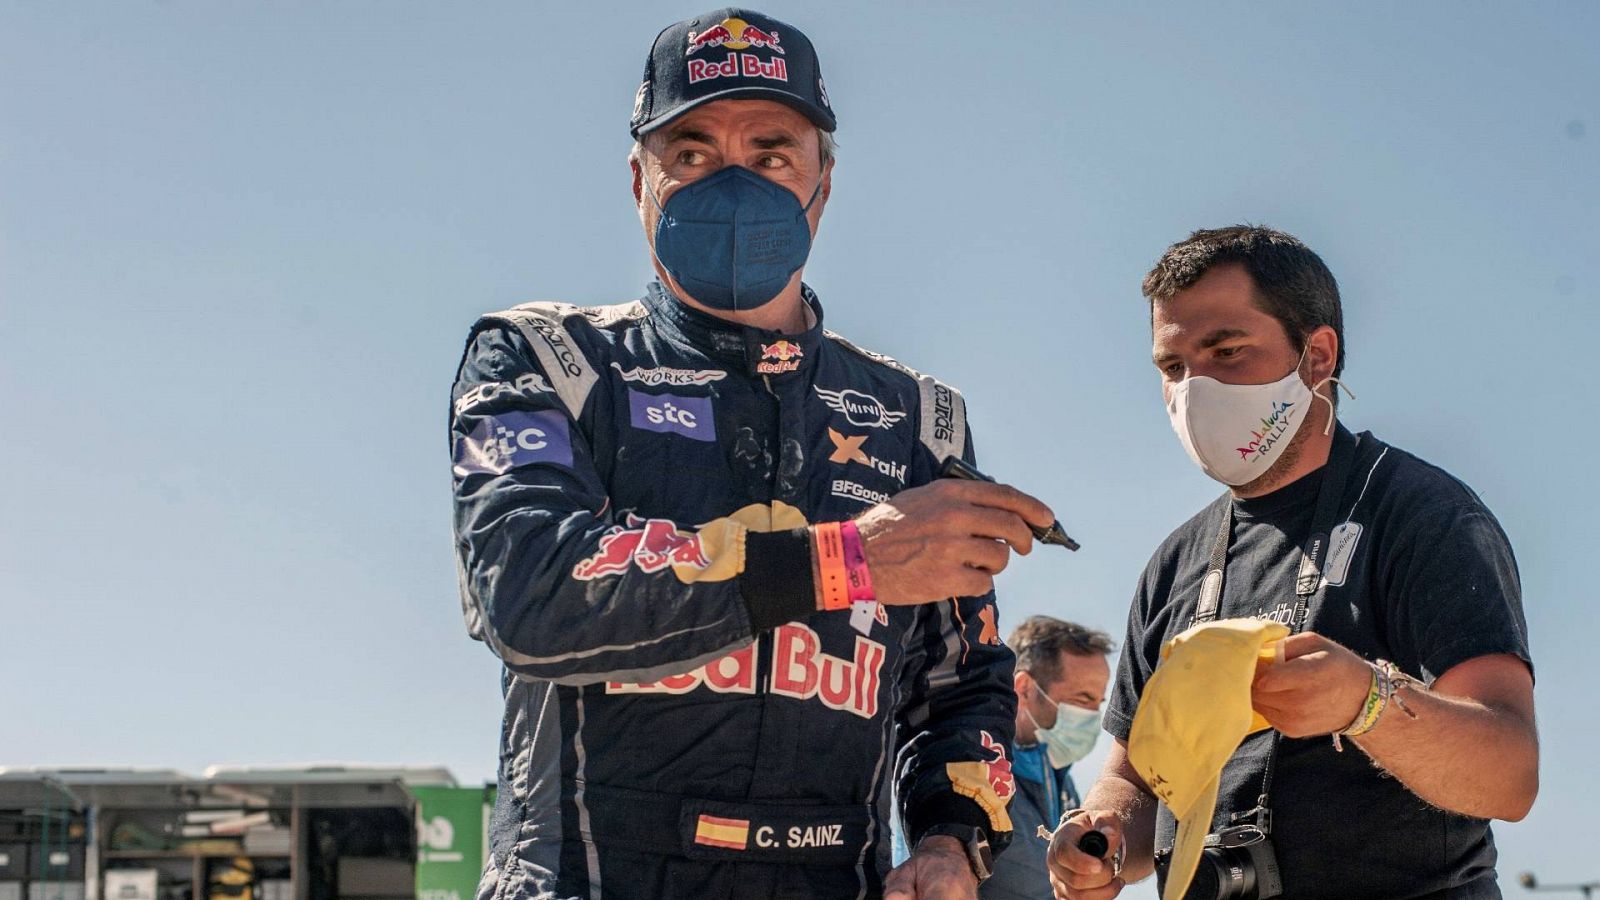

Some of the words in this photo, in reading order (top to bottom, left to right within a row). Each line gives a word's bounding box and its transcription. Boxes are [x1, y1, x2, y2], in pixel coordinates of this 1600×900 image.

[688, 53, 739, 84] Red
[741, 54, 788, 82] Bull
[524, 317, 582, 378] sparco
[637, 370, 695, 384] WORKS
[646, 402, 697, 428] stc
[845, 399, 880, 417] MINI
[934, 384, 953, 441] sparco
[482, 426, 548, 462] stc
[1236, 401, 1295, 461] Andalucía
[1258, 415, 1289, 456] RALLY
[831, 480, 892, 503] BFGood
[770, 621, 886, 719] Bull
[755, 825, 780, 848] C.
[786, 824, 844, 848] SAINZ
